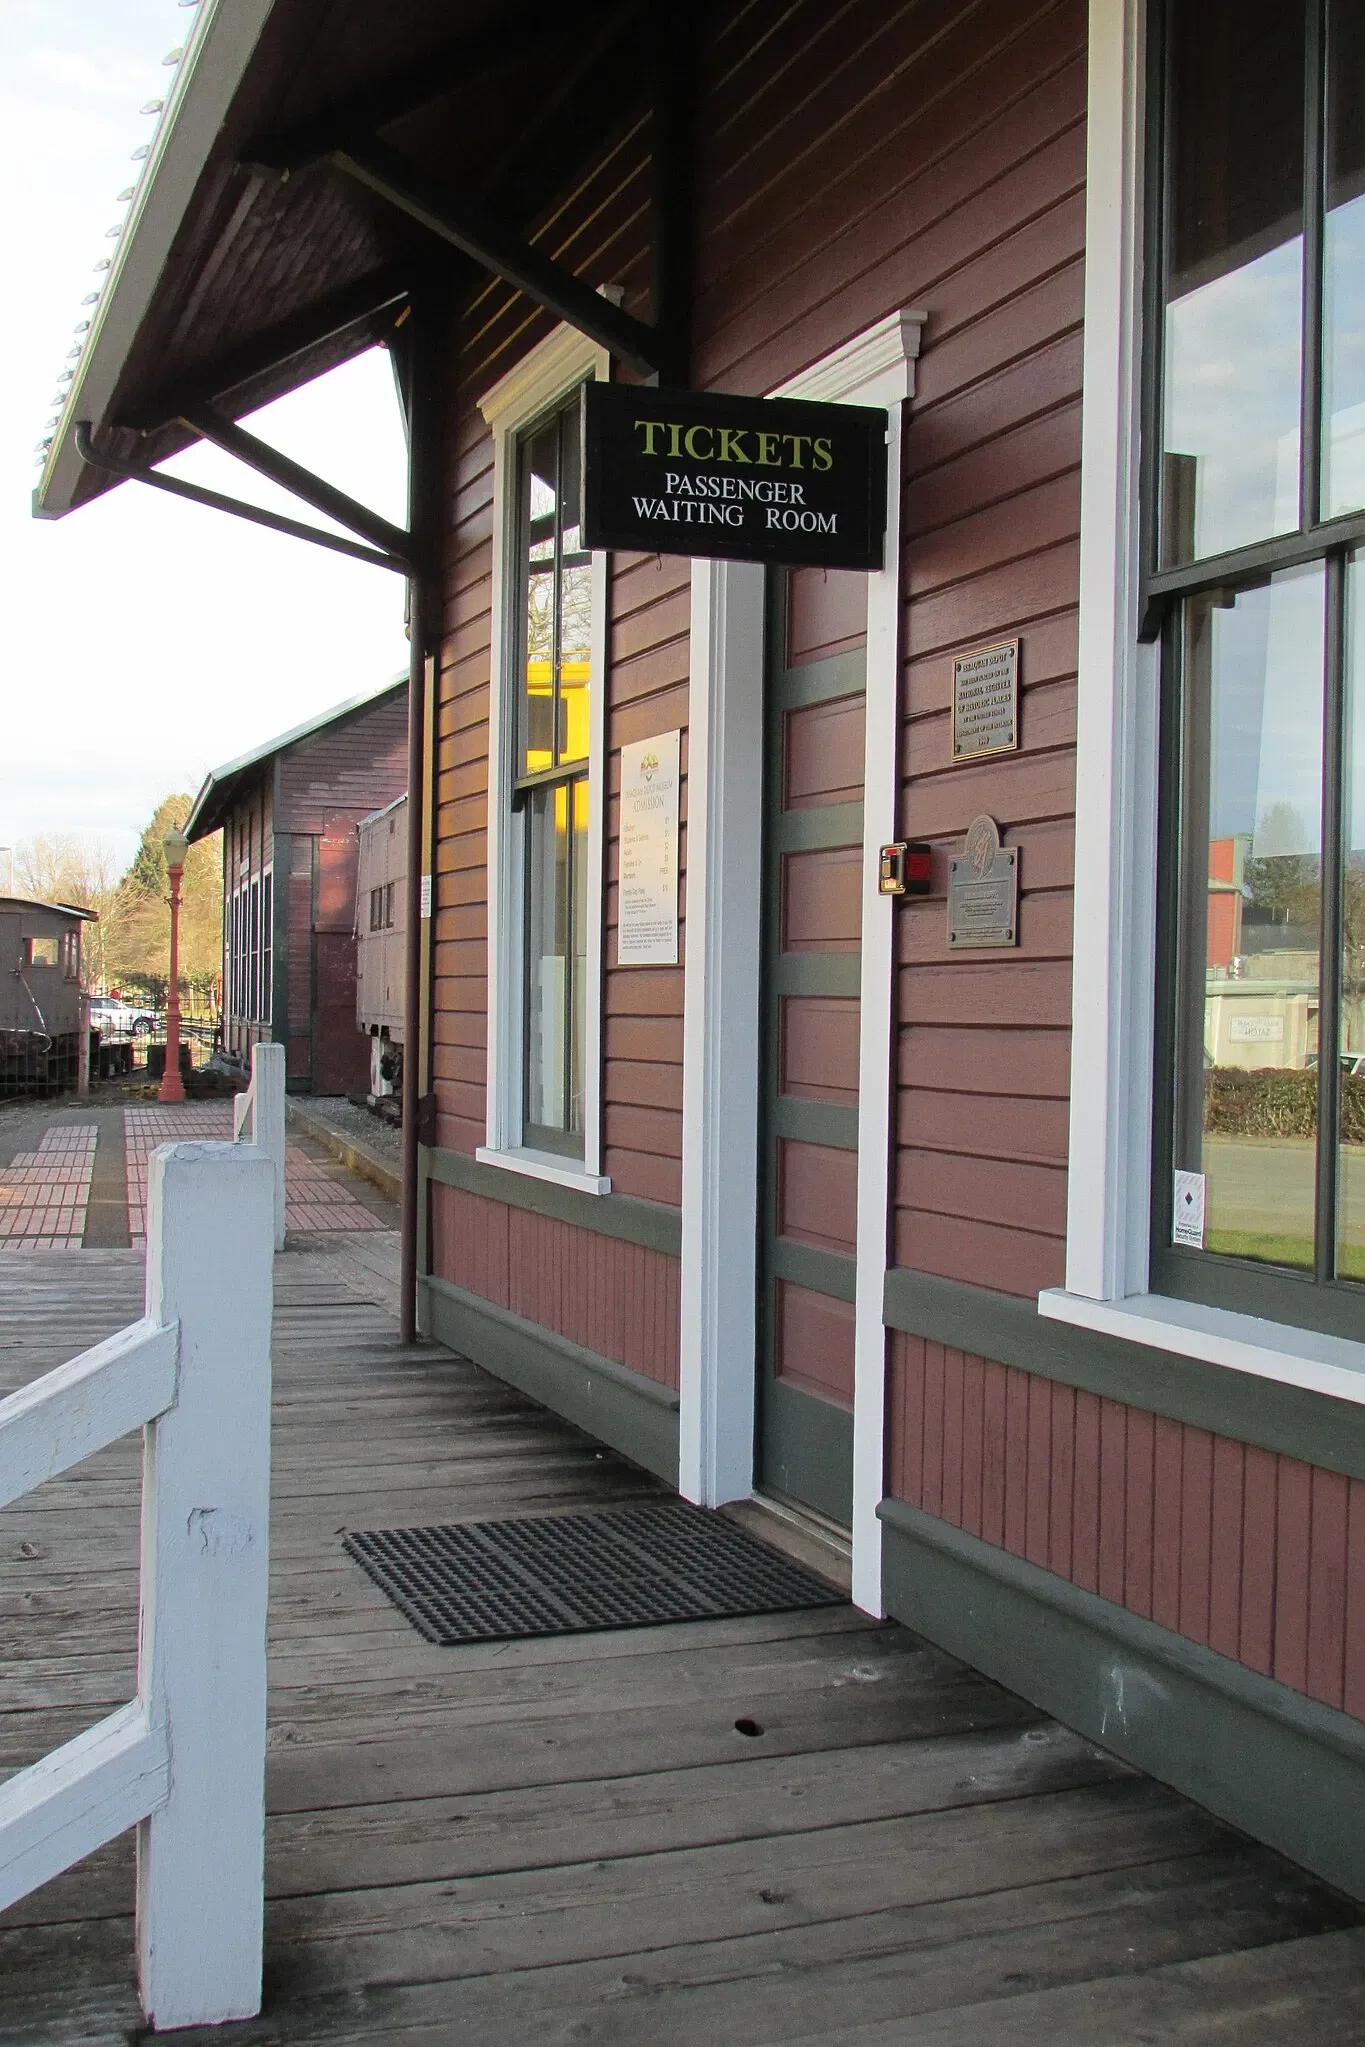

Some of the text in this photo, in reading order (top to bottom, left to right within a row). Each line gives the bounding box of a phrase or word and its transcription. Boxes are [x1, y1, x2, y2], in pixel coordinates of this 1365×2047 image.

[634, 420, 834, 471] TICKETS
[665, 472, 807, 506] PASSENGER
[631, 496, 838, 534] WAITING ROOM
[632, 794, 665, 812] ADMISSION
